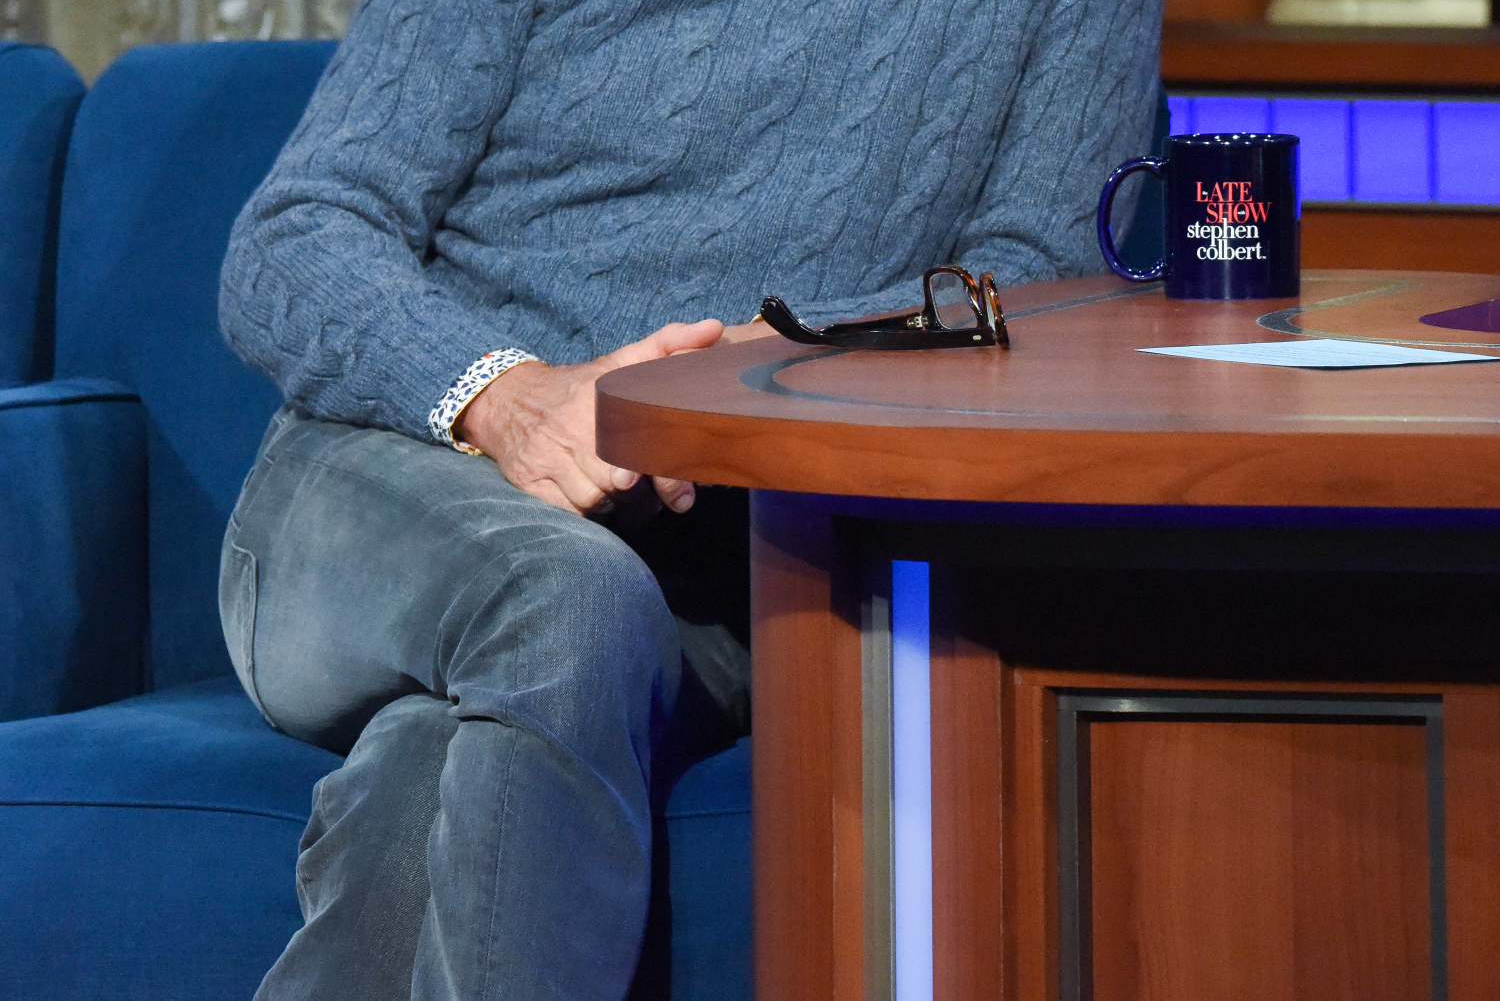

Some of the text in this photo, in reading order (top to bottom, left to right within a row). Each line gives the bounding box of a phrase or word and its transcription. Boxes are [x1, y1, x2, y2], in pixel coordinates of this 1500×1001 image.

[1195, 181, 1253, 203] LATE
[1205, 202, 1272, 224] SHOW
[1187, 217, 1260, 247] stephen
[1196, 239, 1262, 260] colbert
